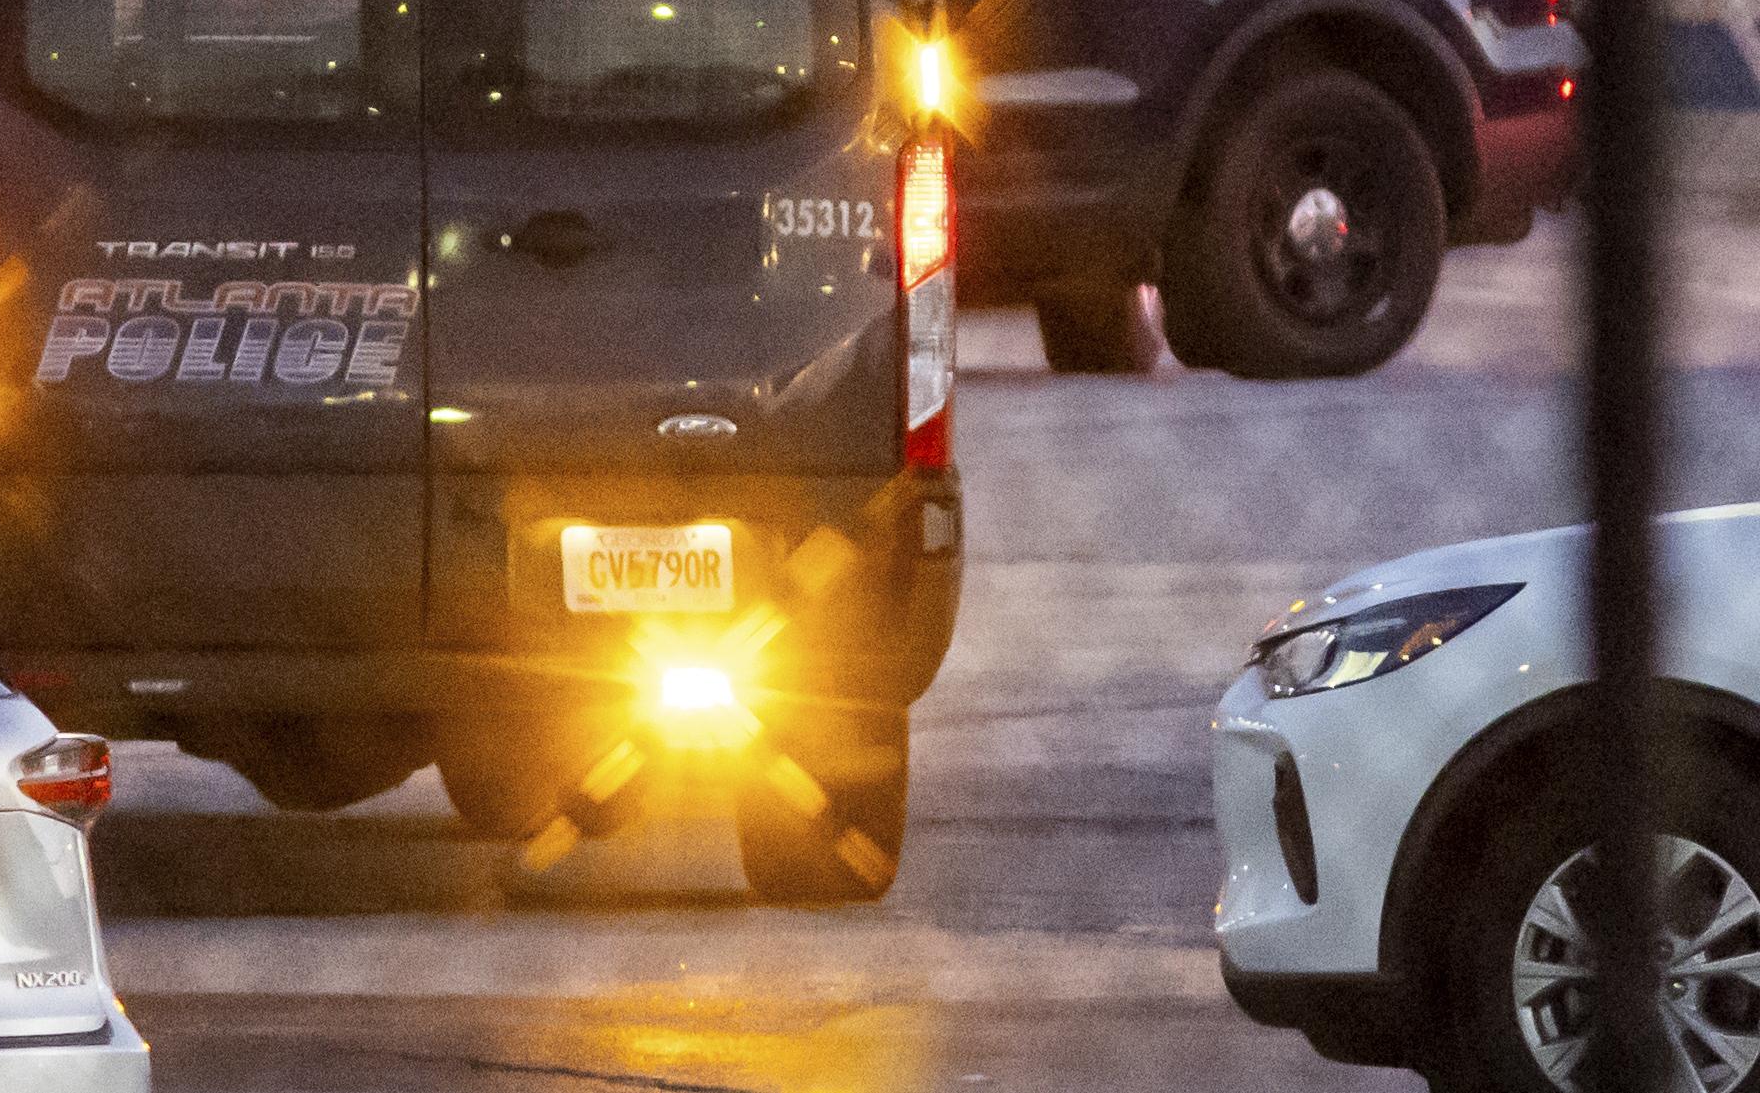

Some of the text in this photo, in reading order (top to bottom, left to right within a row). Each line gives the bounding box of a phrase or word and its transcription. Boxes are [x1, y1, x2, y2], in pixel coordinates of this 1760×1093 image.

[776, 197, 875, 238] 35312
[96, 241, 299, 259] TRANSIT
[58, 278, 420, 316] ATLANTA
[36, 315, 409, 386] POLICE
